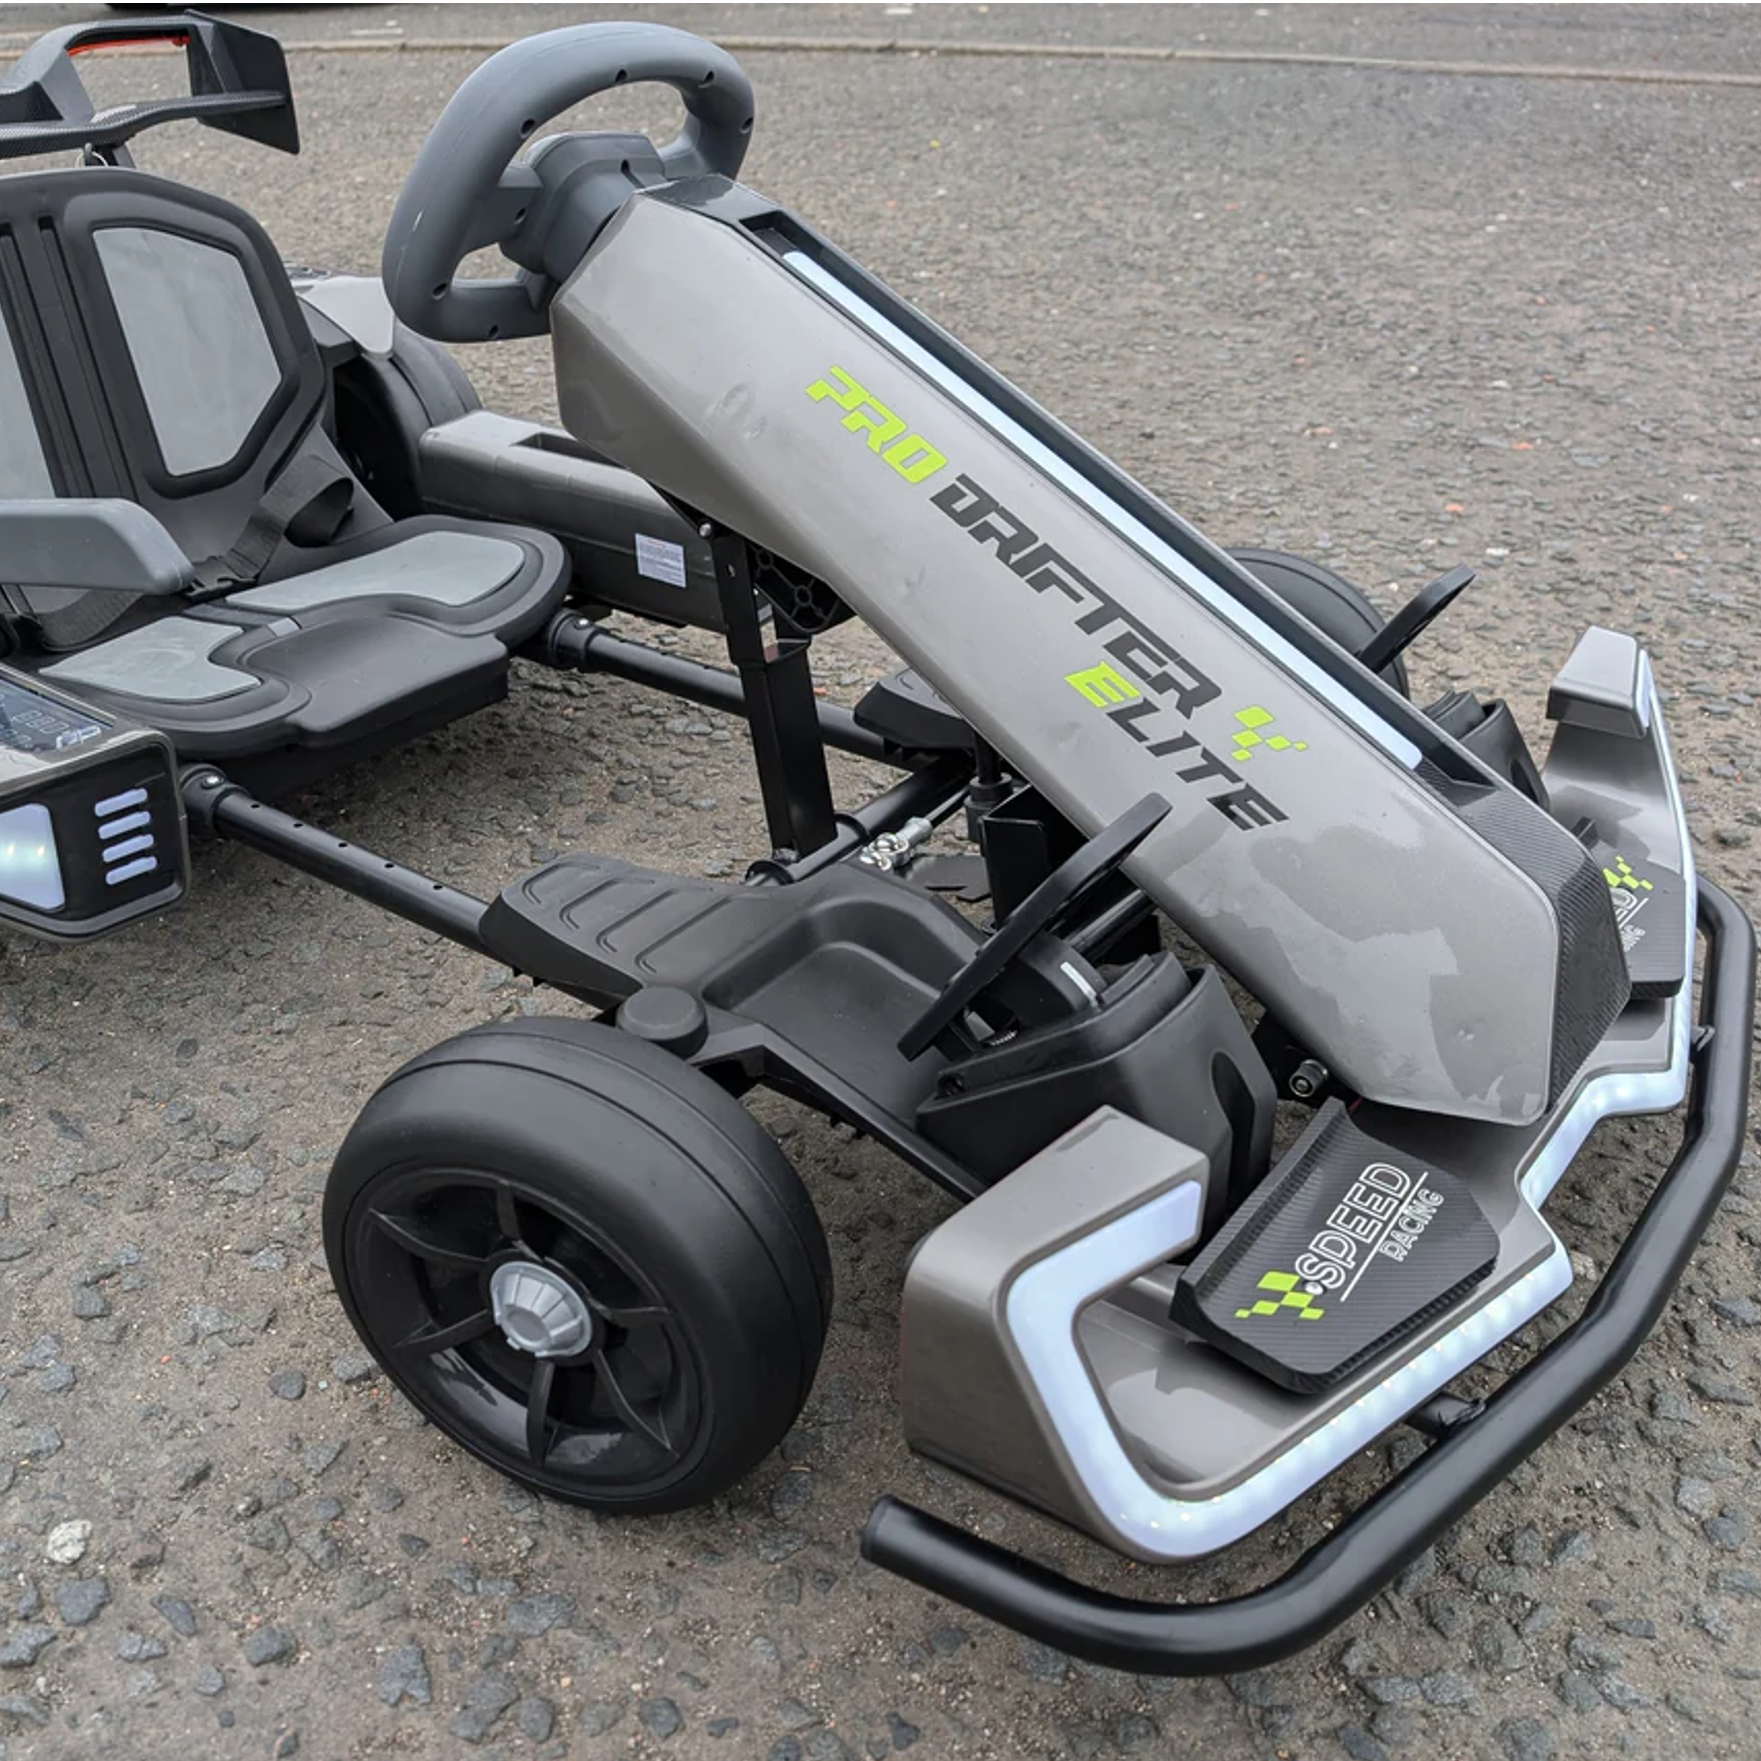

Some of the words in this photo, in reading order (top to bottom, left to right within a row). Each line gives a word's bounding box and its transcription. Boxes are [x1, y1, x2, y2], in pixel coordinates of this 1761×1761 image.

[806, 365, 948, 485] PRO
[930, 473, 1222, 720] DRIFTER
[1064, 660, 1289, 832] ELITE
[1294, 1162, 1411, 1289] SPEED
[1379, 1188, 1445, 1262] RACING
